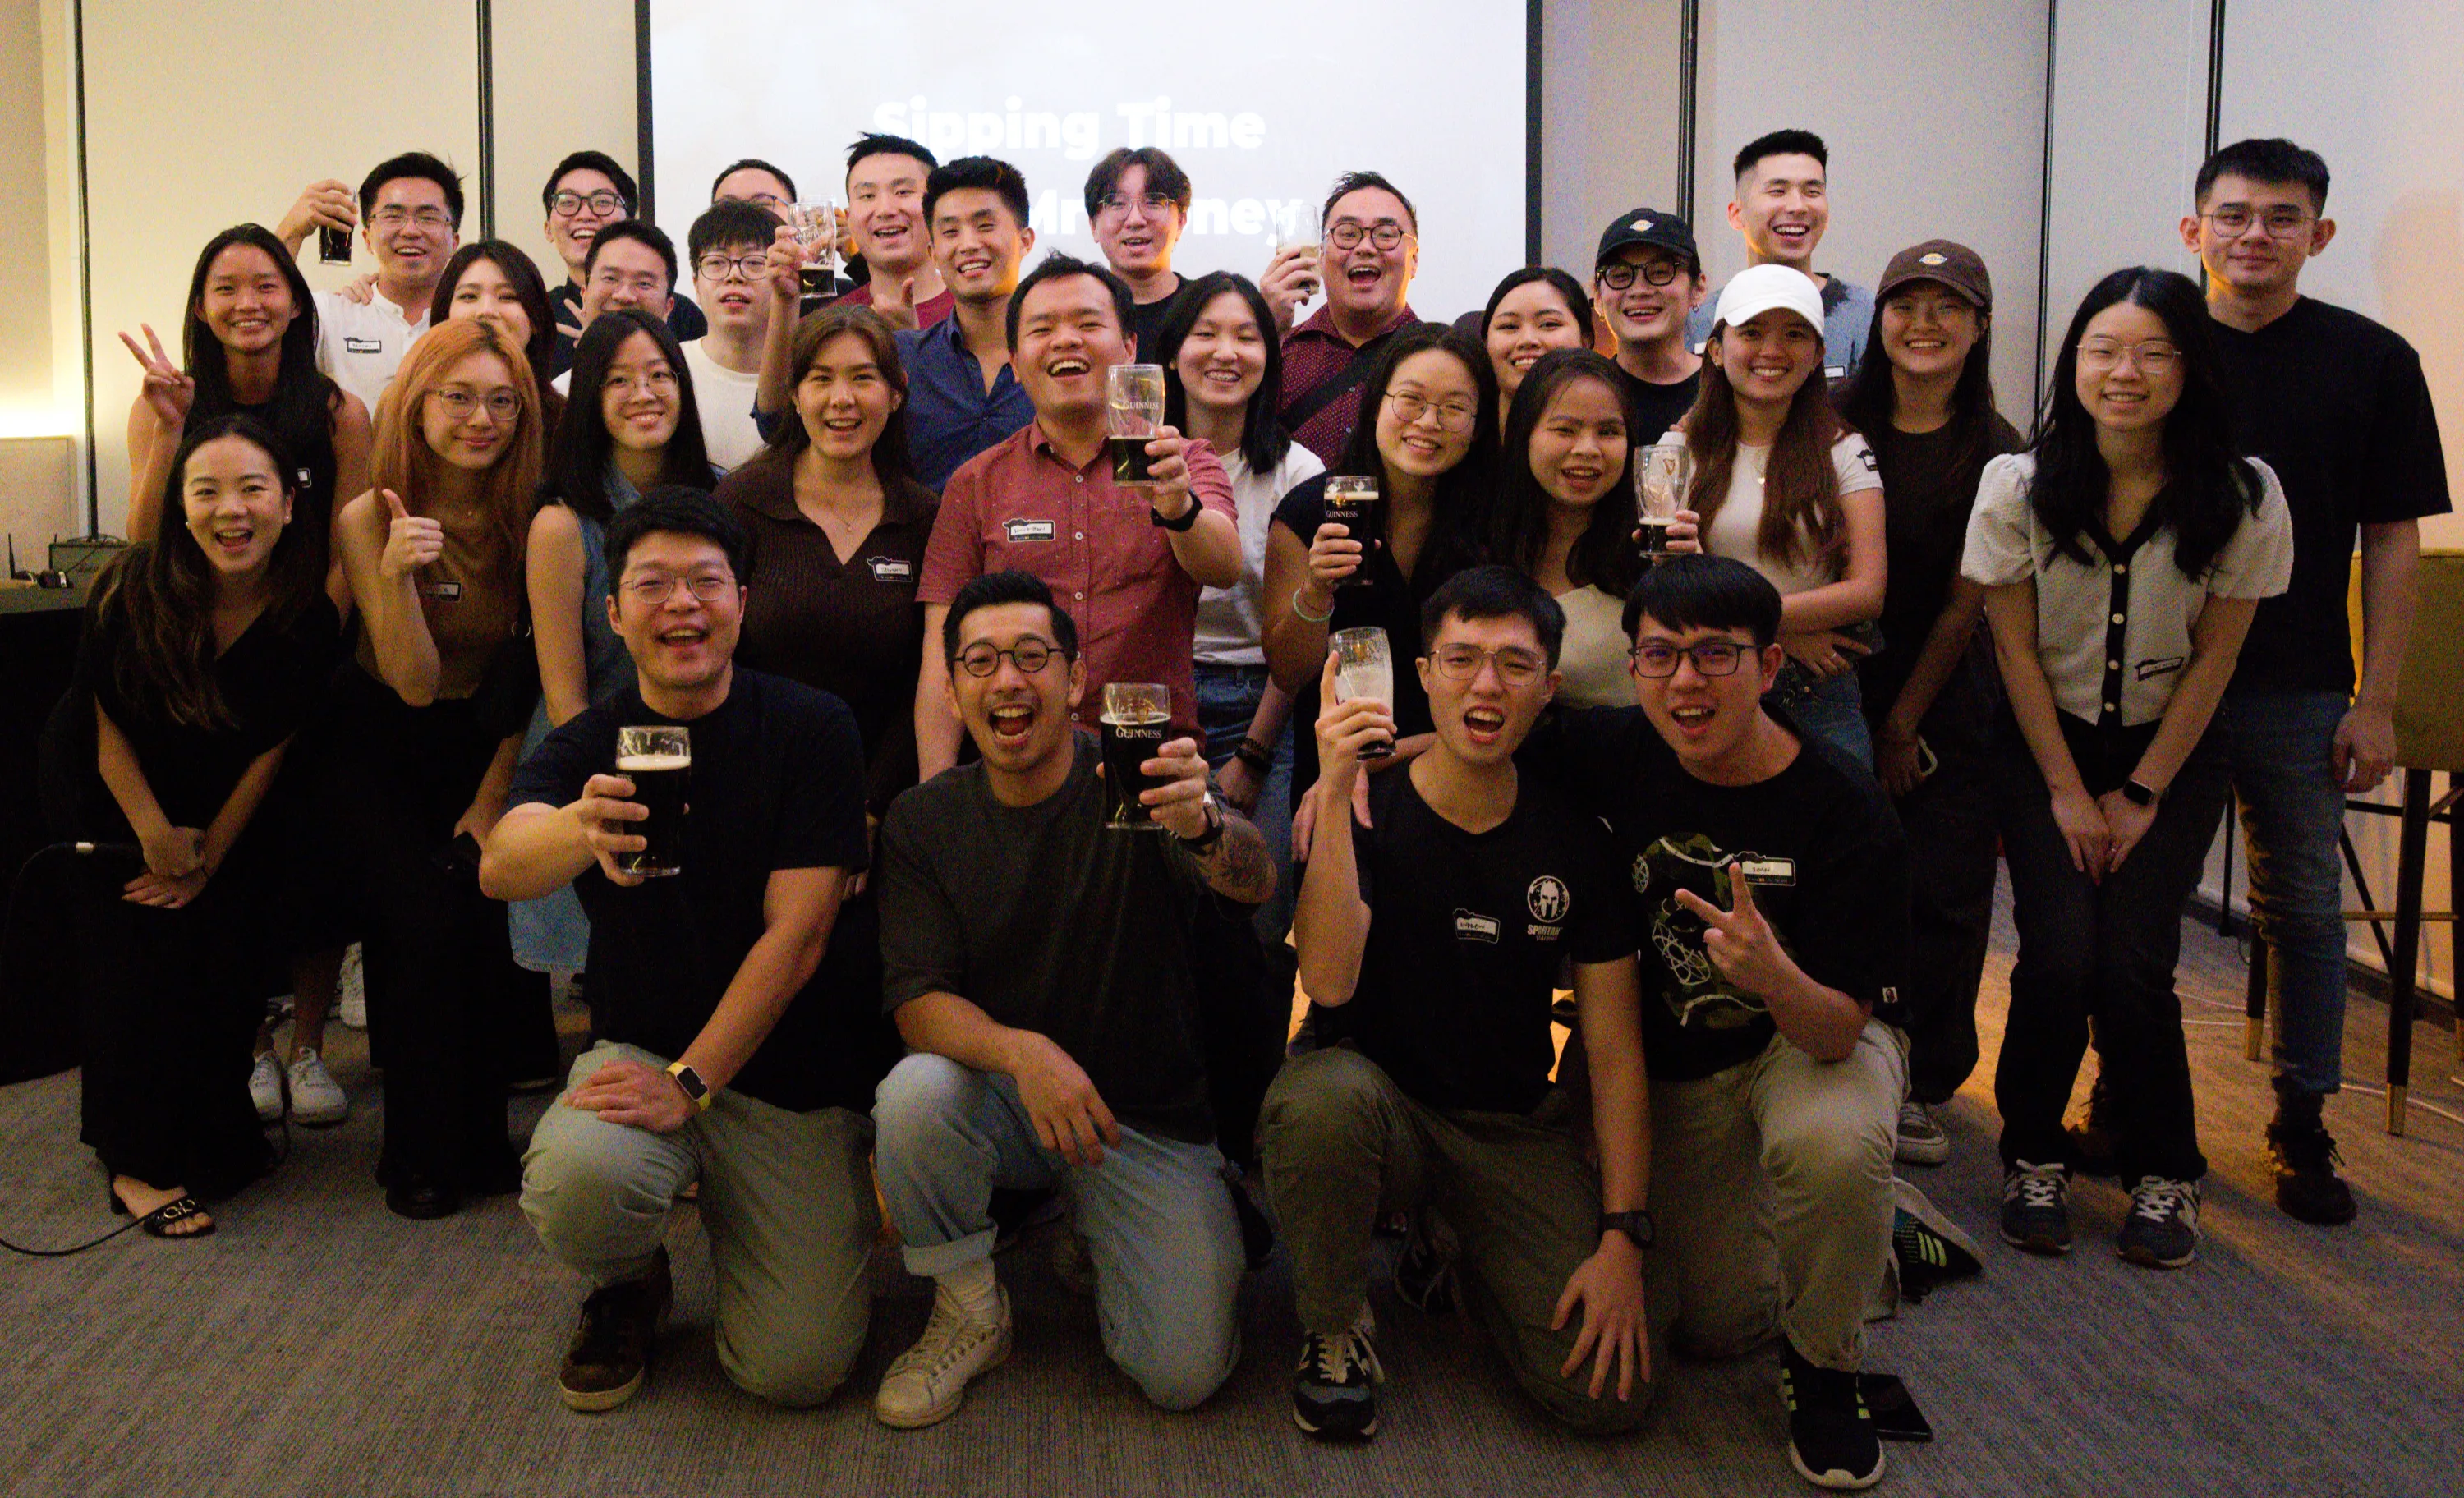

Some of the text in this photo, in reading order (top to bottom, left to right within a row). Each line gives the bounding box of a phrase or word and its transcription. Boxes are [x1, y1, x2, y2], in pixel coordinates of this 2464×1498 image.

[872, 94, 1266, 160] Sipping Time
[1123, 401, 1160, 410] GUINNESS
[1326, 510, 1358, 519] GUINNESS
[1115, 726, 1162, 740] GUINNESS
[1527, 924, 1561, 936] SPARTAN
